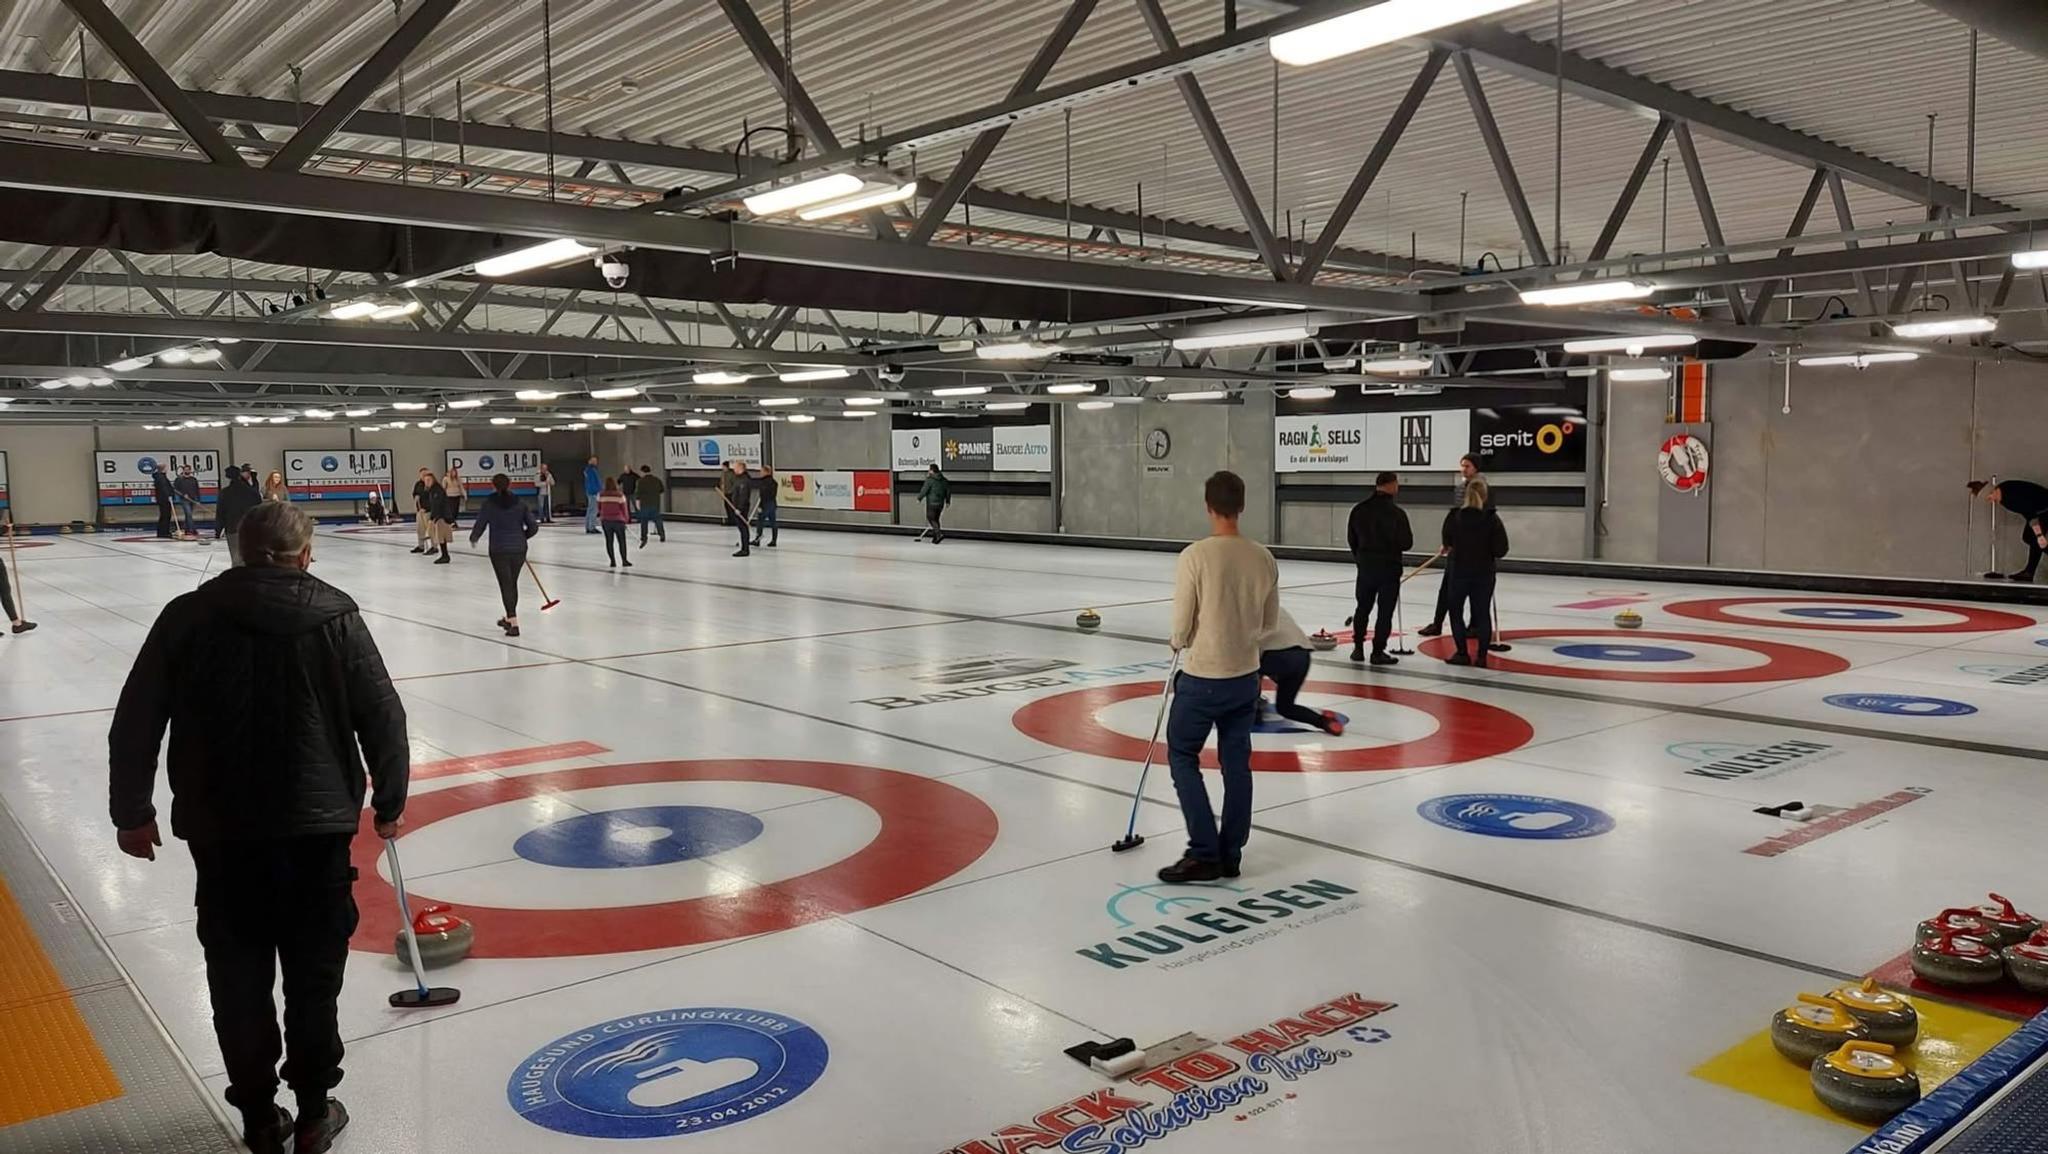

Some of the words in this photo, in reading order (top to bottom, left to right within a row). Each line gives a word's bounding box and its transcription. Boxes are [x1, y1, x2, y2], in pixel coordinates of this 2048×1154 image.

[1279, 431, 1308, 446] RAGN
[1328, 429, 1361, 445] SELLS
[1480, 430, 1533, 447] serit
[103, 460, 116, 474] B
[291, 458, 303, 471] C
[452, 457, 463, 469] D
[1065, 659, 1176, 681] AUT
[1076, 879, 1359, 969] KULEISEN
[1129, 1051, 1240, 1095] TO
[1222, 991, 1399, 1055] HACK
[521, 1033, 595, 1107] HAUGESUND
[603, 1009, 789, 1034] CURLINGKLUBB
[675, 1085, 788, 1129] 23.04.2012
[1061, 1073, 1268, 1154] Solution
[1247, 1045, 1352, 1081] Inc.
